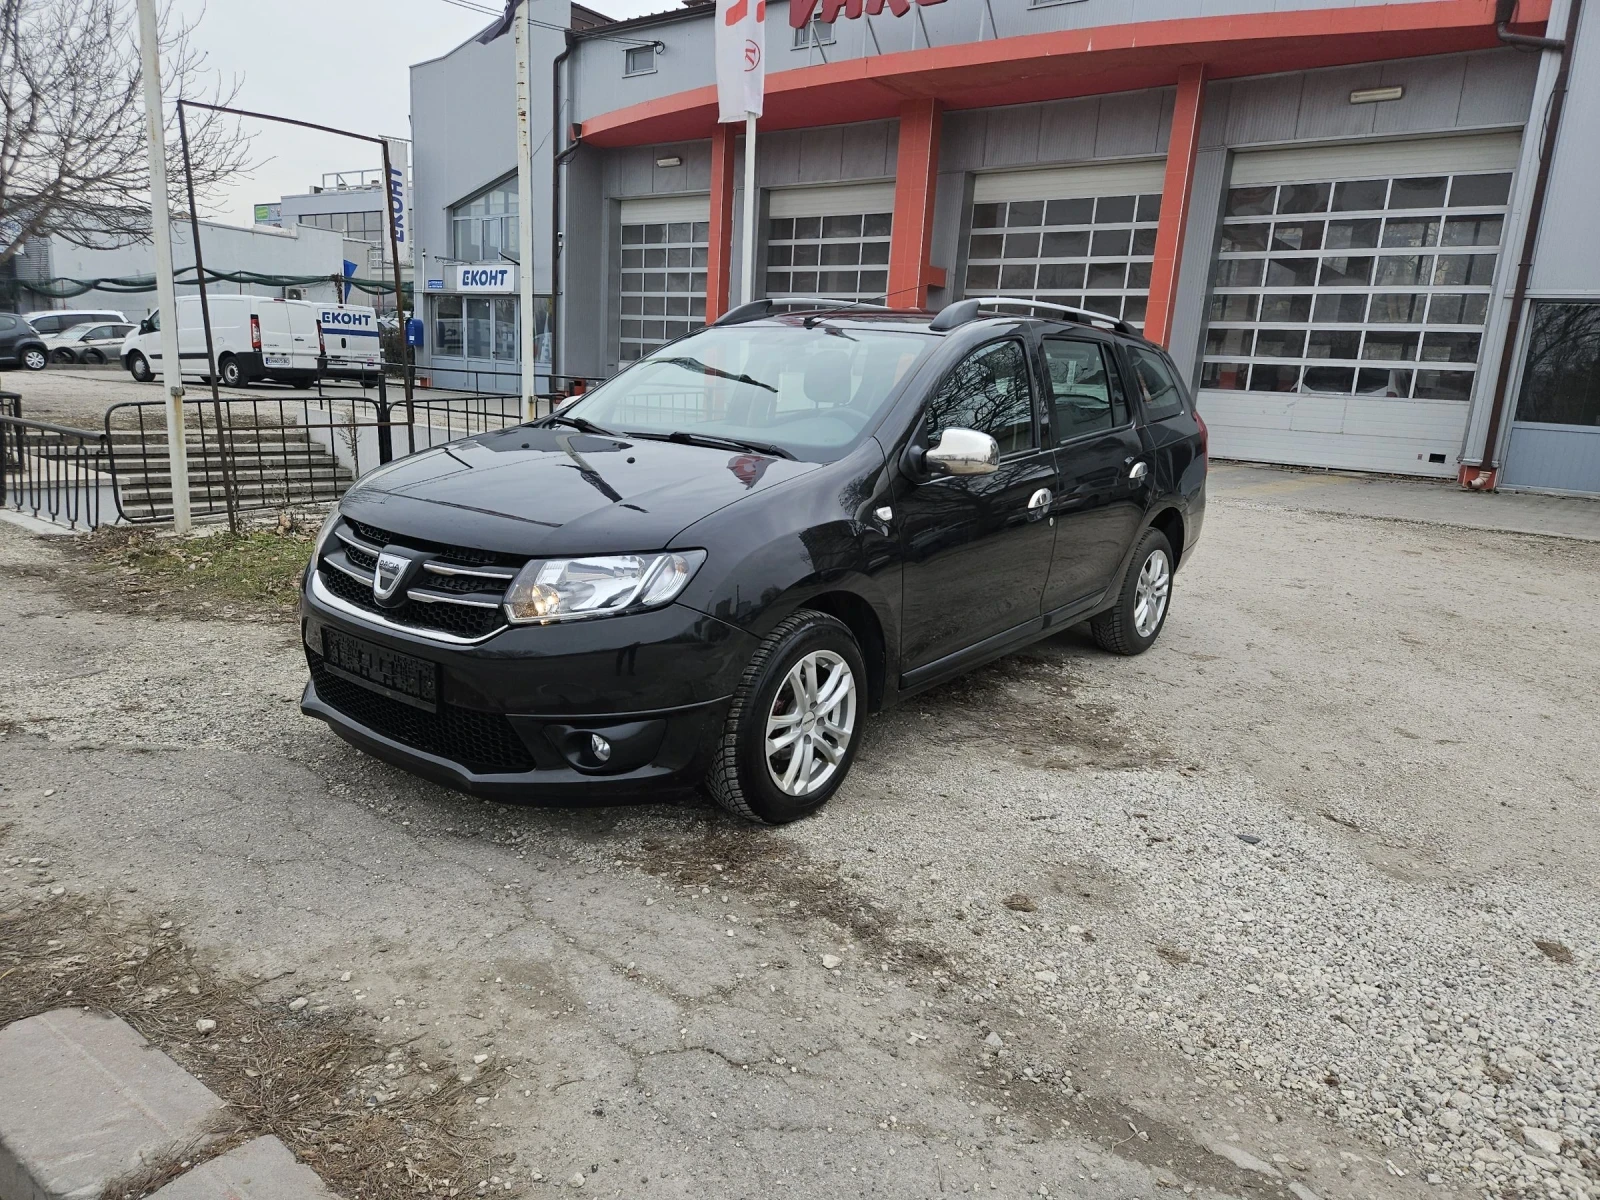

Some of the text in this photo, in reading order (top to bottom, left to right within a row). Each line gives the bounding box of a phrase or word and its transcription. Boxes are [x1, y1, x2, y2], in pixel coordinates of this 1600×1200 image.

[462, 270, 508, 286] ЕКОНТ
[321, 311, 371, 326] ЕКОНТ
[379, 559, 400, 570] DACIA
